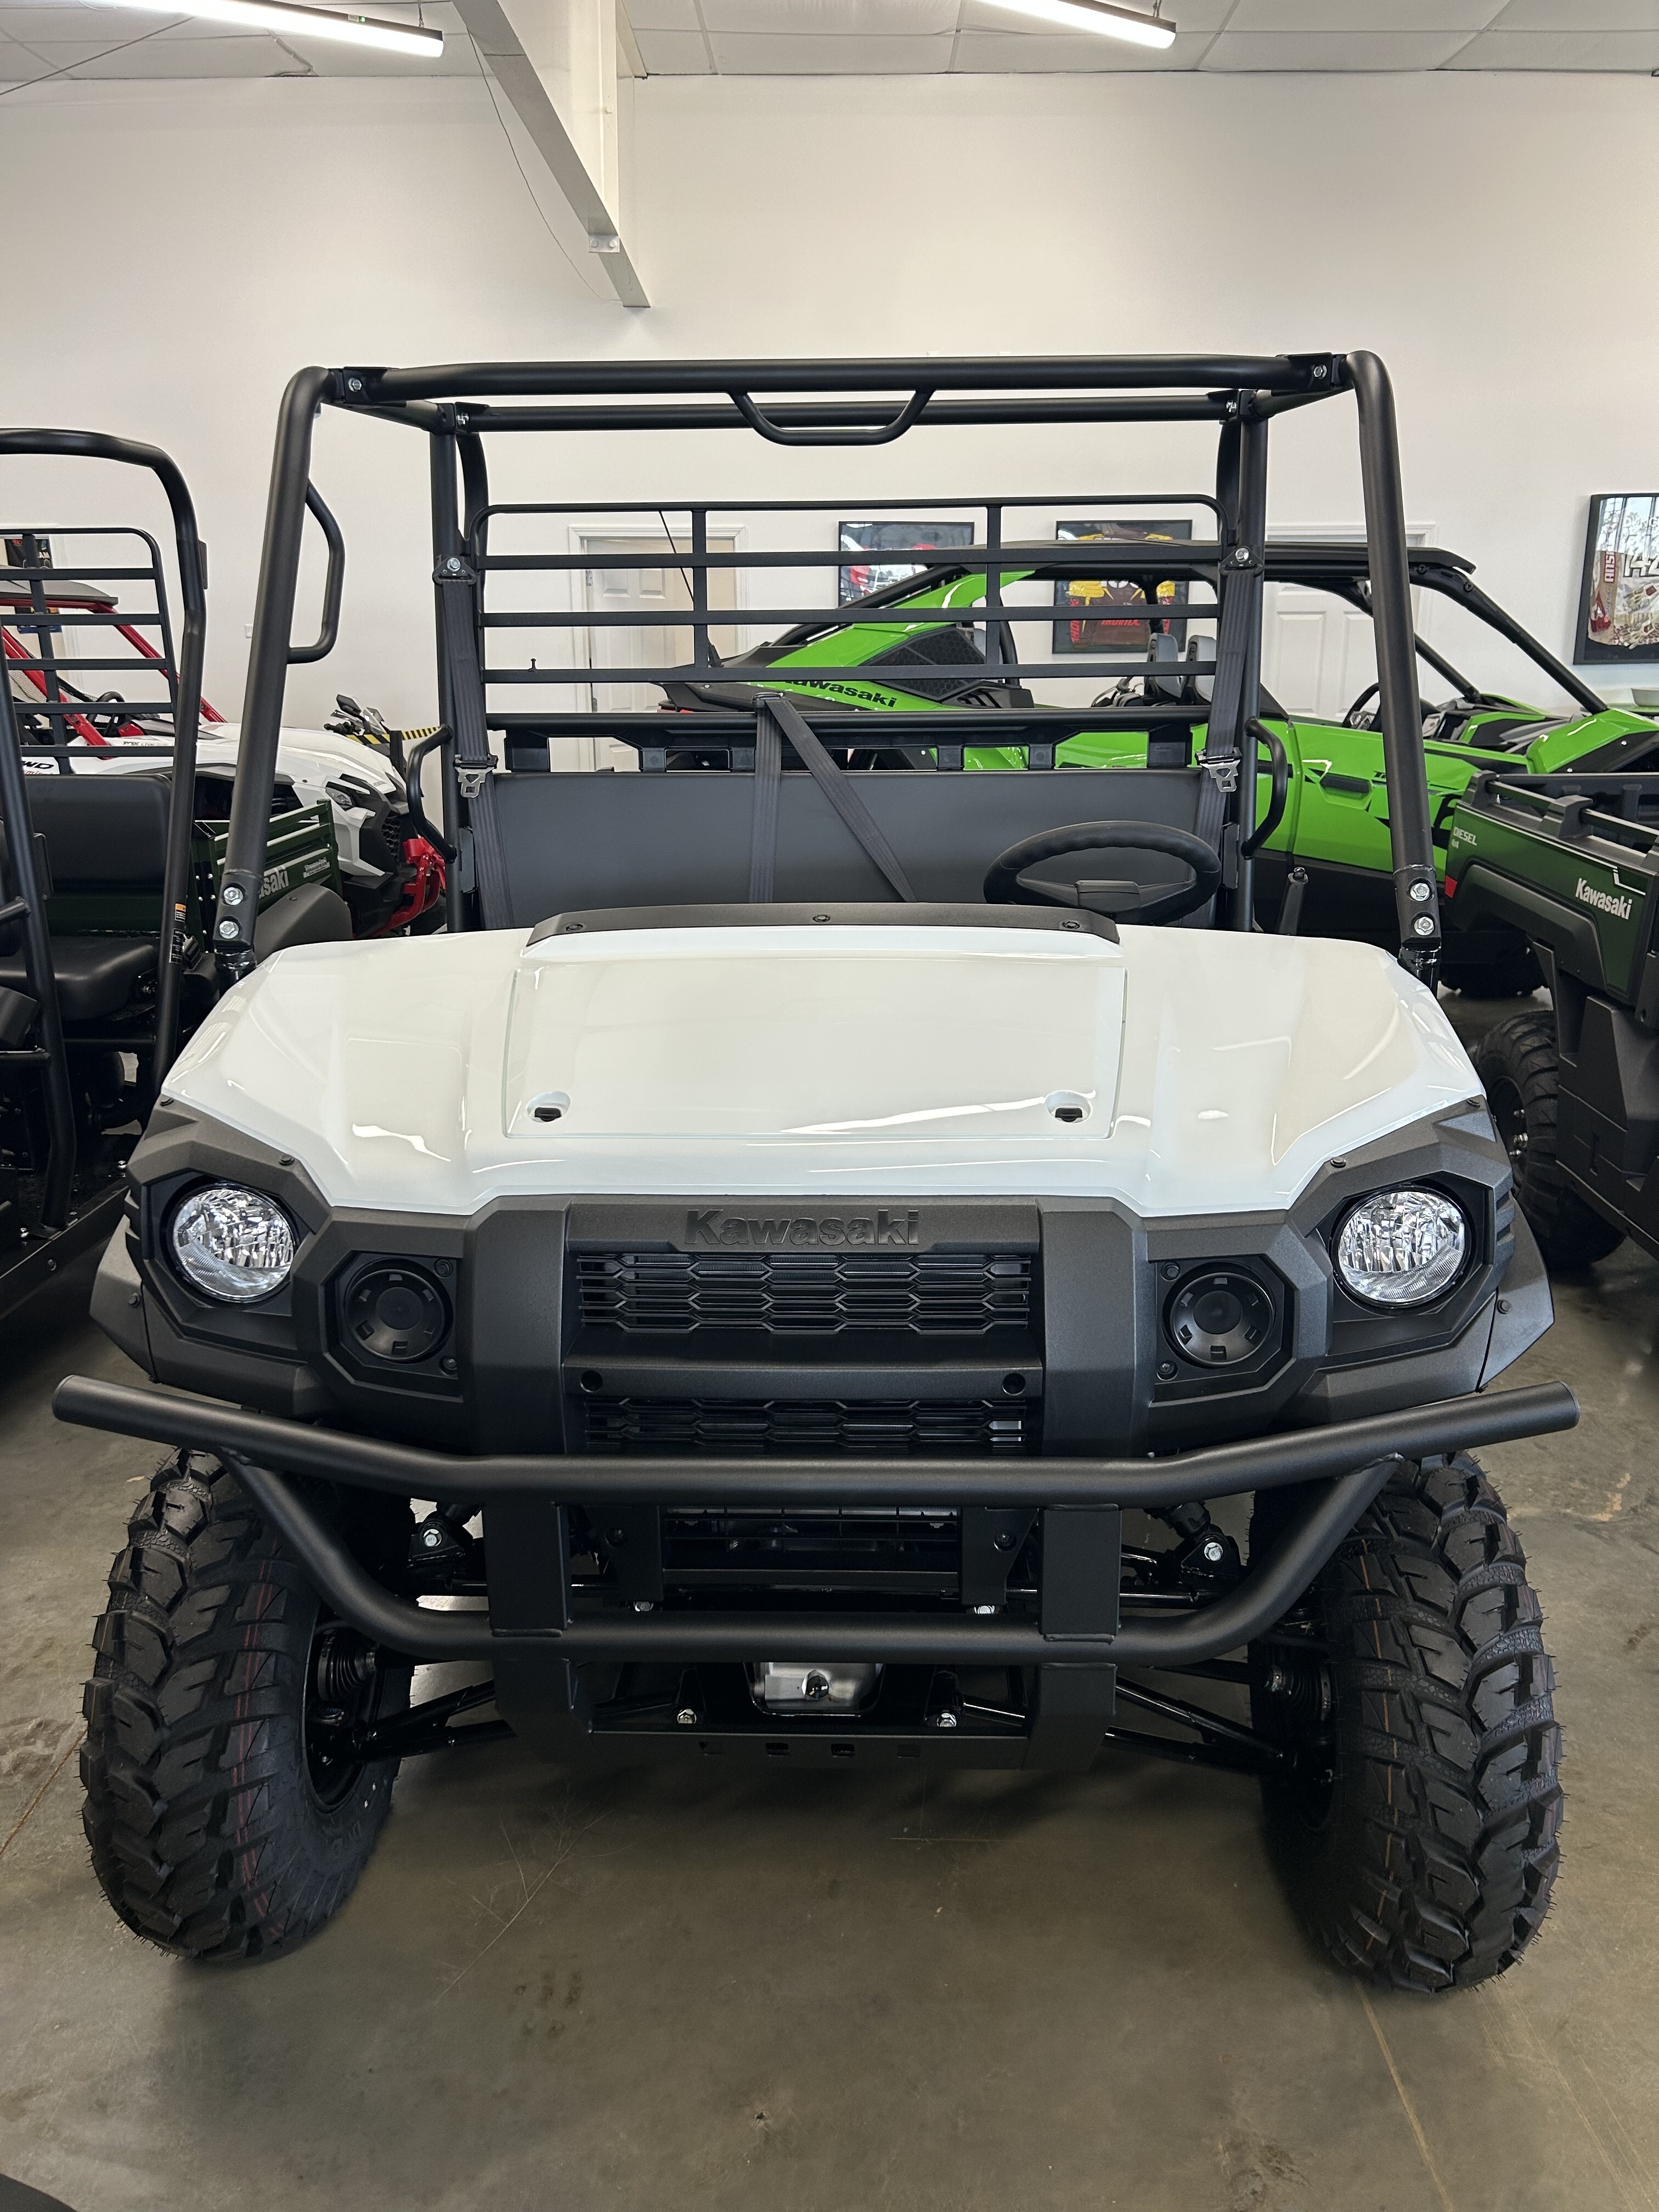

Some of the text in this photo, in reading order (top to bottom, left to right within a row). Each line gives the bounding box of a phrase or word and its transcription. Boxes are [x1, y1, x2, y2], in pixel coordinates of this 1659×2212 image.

[785, 681, 898, 708] wasaki
[1453, 826, 1477, 846] DIESEL
[1575, 878, 1633, 920] Kawasaki
[685, 1209, 919, 1245] Kawasaki
